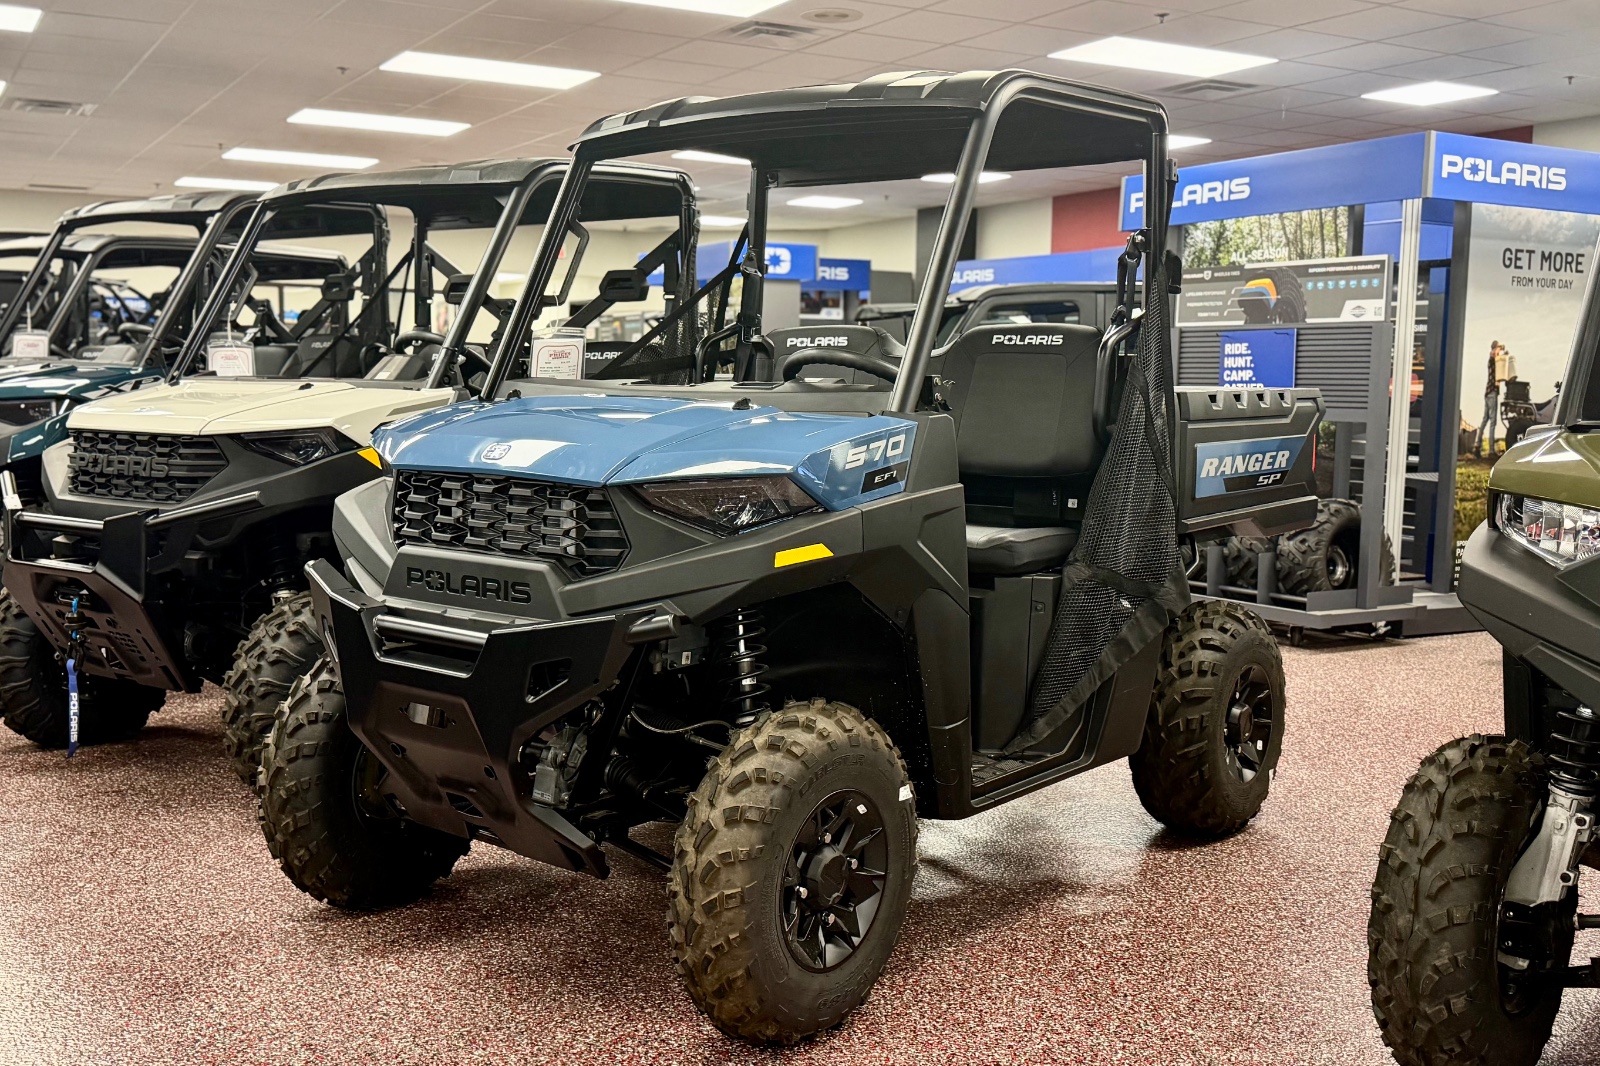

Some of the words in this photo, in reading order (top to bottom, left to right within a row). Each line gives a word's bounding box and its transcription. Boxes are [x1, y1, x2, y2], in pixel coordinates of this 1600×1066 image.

[1441, 154, 1567, 191] POLARIS
[1129, 177, 1251, 213] PARIS
[1230, 247, 1289, 262] ALL-SEASON
[1502, 247, 1536, 271] GET
[1540, 250, 1585, 273] MORE
[951, 268, 994, 284] LARIS
[1511, 275, 1533, 287] FROM
[1535, 277, 1556, 289] YOUR
[1558, 279, 1573, 290] DAY
[786, 336, 848, 348] POLARIS
[991, 334, 1064, 345] POLARIS
[1224, 343, 1251, 355] RIDE.
[1224, 356, 1255, 368] HUNT.
[1223, 369, 1256, 381] CAMP.
[845, 434, 905, 470] 570
[73, 451, 168, 478] POLARIS
[1200, 450, 1290, 478] RANGER
[874, 470, 897, 483] EFI
[1256, 473, 1281, 486] SP
[406, 566, 532, 605] POLARIS
[70, 692, 79, 743] POLARIS
